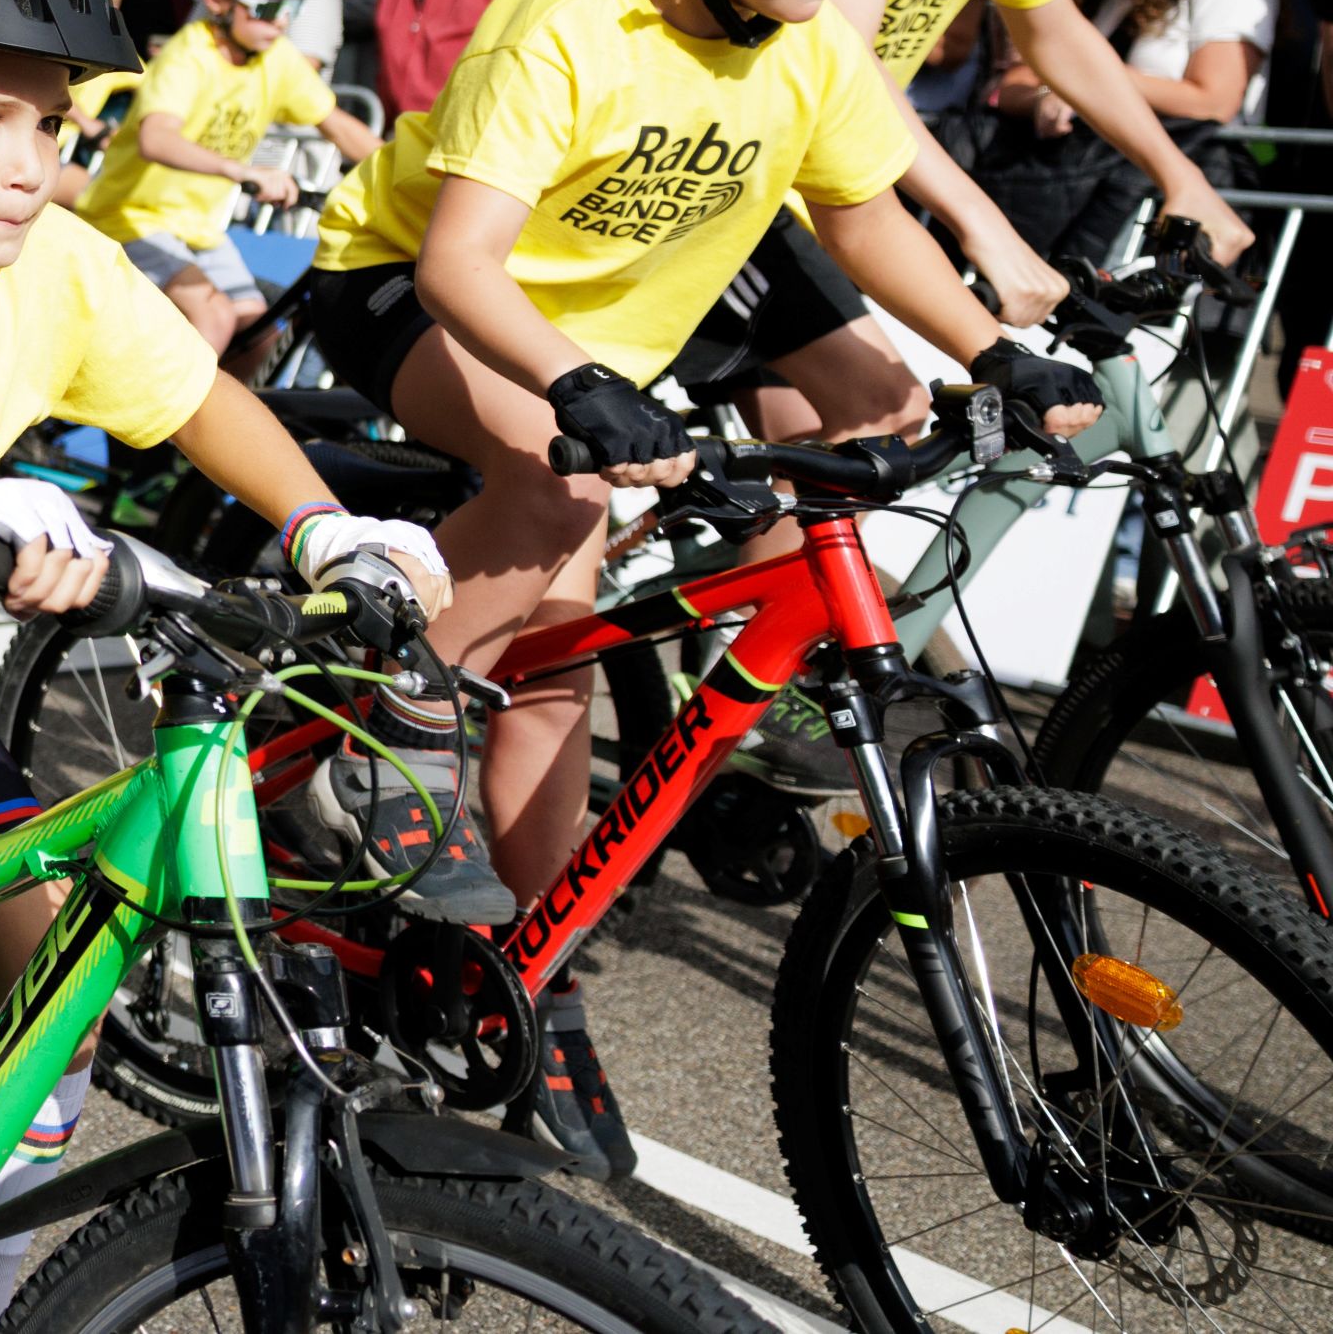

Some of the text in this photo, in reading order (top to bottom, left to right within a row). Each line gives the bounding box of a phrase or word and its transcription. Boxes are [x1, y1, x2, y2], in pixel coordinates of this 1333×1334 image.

[615, 122, 762, 177] Rabo
[595, 176, 702, 201] DIKKE
[559, 207, 662, 245] RACE
[504, 693, 715, 976] ROCKRIDER
